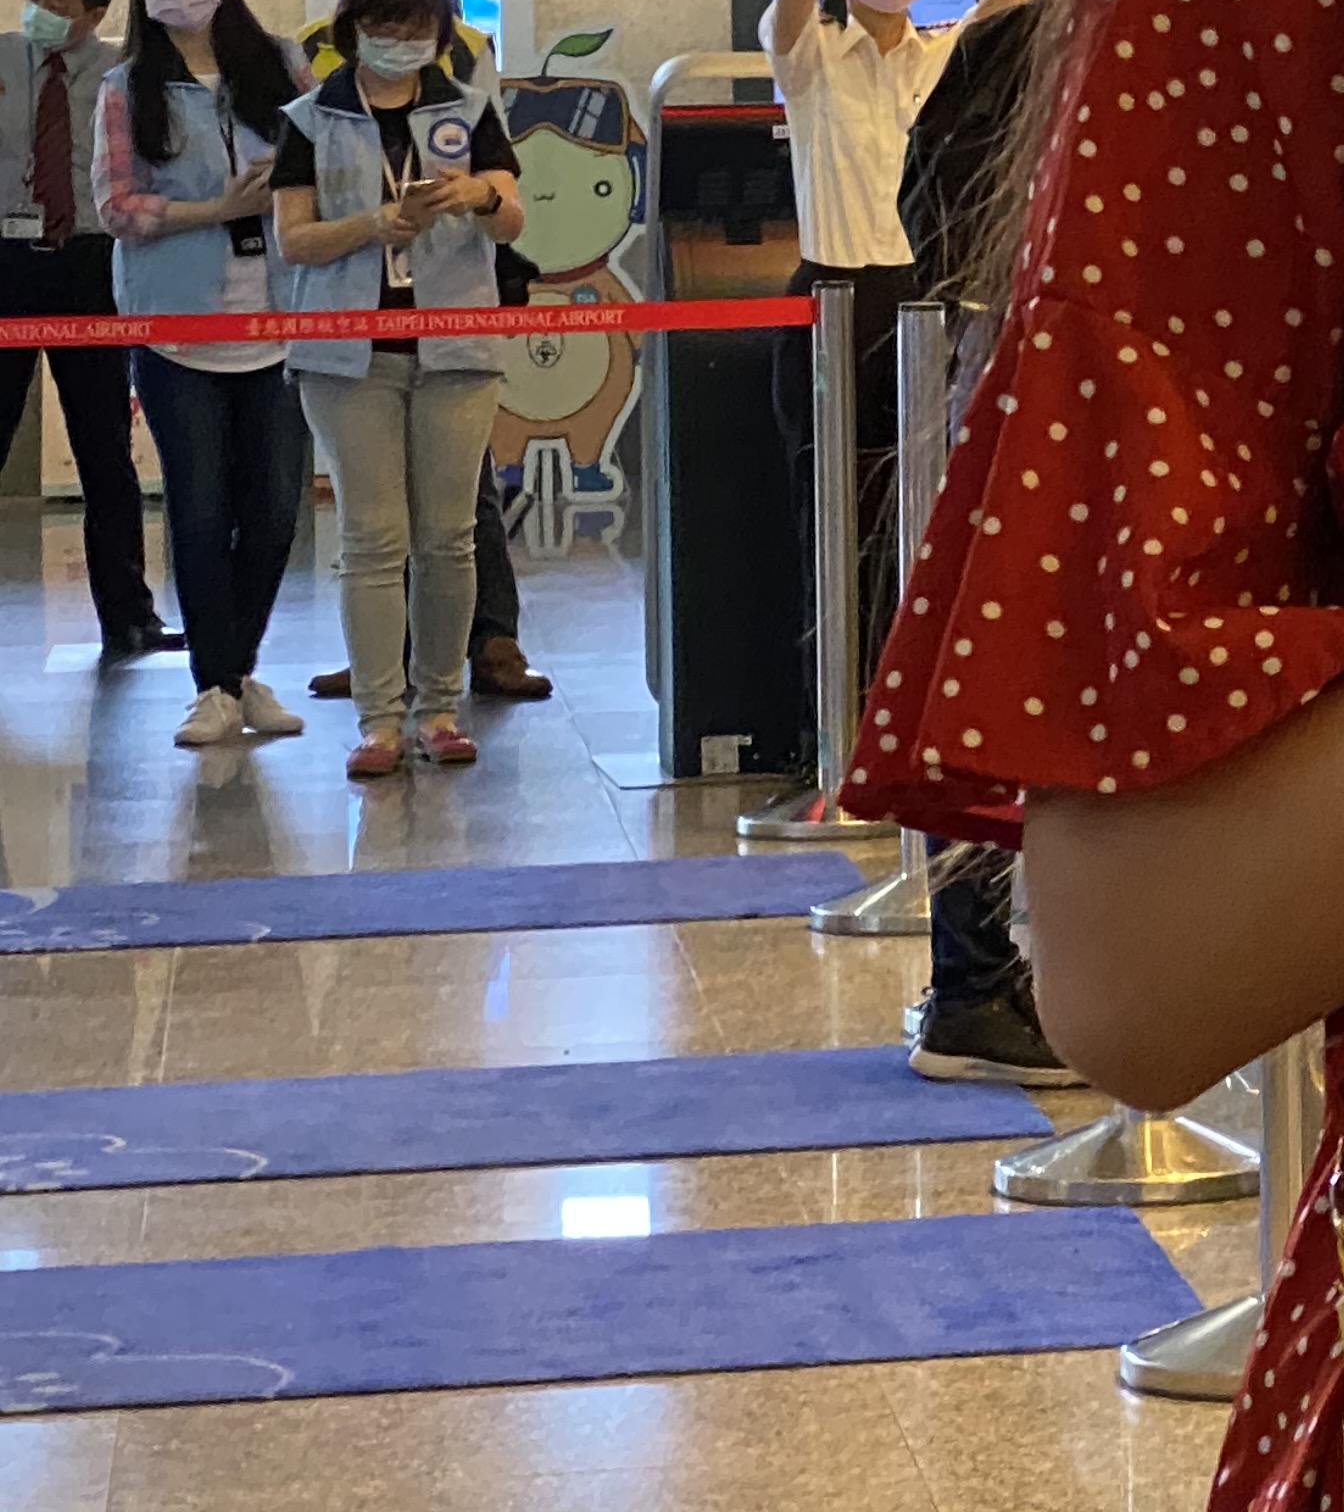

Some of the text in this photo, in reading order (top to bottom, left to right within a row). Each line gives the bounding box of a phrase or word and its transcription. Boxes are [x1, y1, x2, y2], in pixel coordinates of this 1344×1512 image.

[85, 320, 153, 339] AIRPORT
[376, 314, 426, 332] TAIPEI
[427, 310, 553, 331] INTERNATIONAL
[559, 308, 624, 326] AIRPORT
